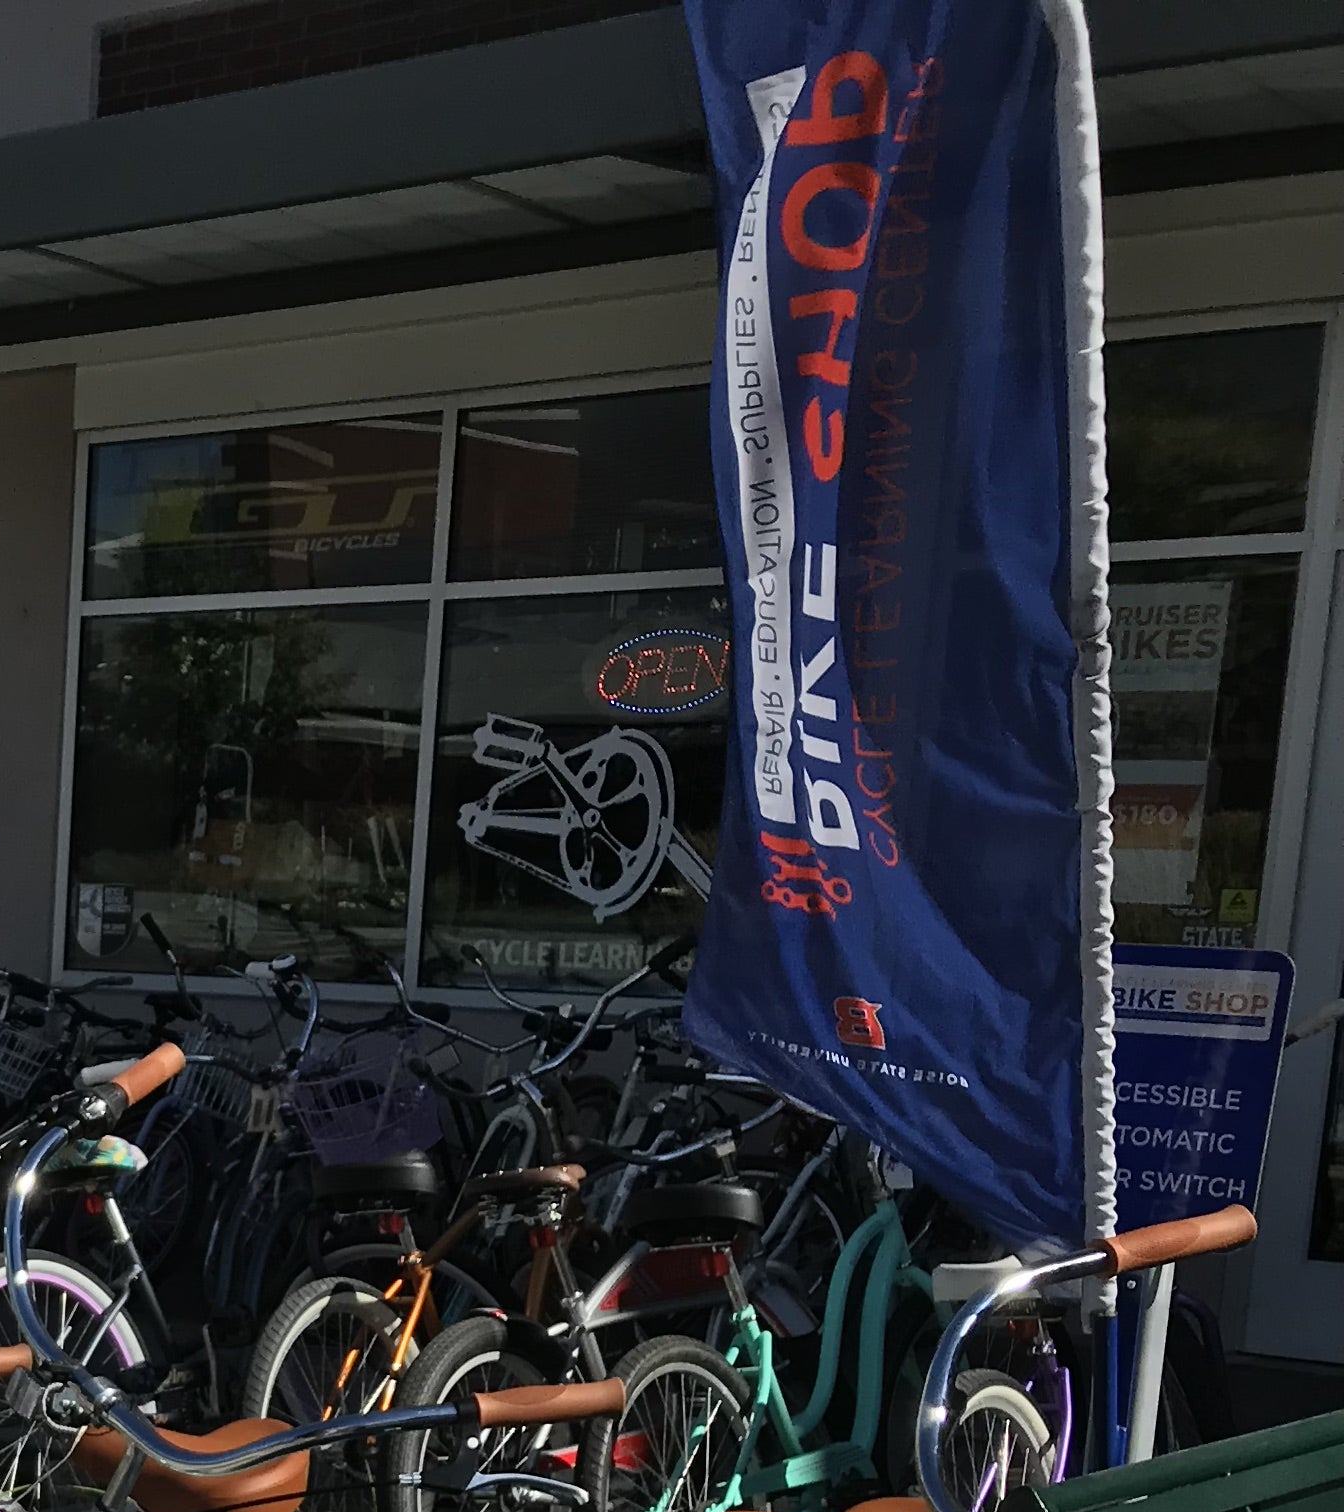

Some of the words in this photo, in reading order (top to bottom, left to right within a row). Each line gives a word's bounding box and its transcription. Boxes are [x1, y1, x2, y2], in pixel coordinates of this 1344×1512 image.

[293, 531, 401, 554] BICYCLES
[1116, 603, 1222, 627] RUISER
[1119, 627, 1222, 661] IKES
[597, 640, 731, 700] OPEN
[1112, 986, 1177, 1010] BIKE
[1185, 990, 1270, 1015] SHOP
[1115, 1080, 1243, 1112] CESSIBLE
[1116, 1124, 1236, 1155] TOMATIC
[1139, 1169, 1246, 1200] SWITCH
